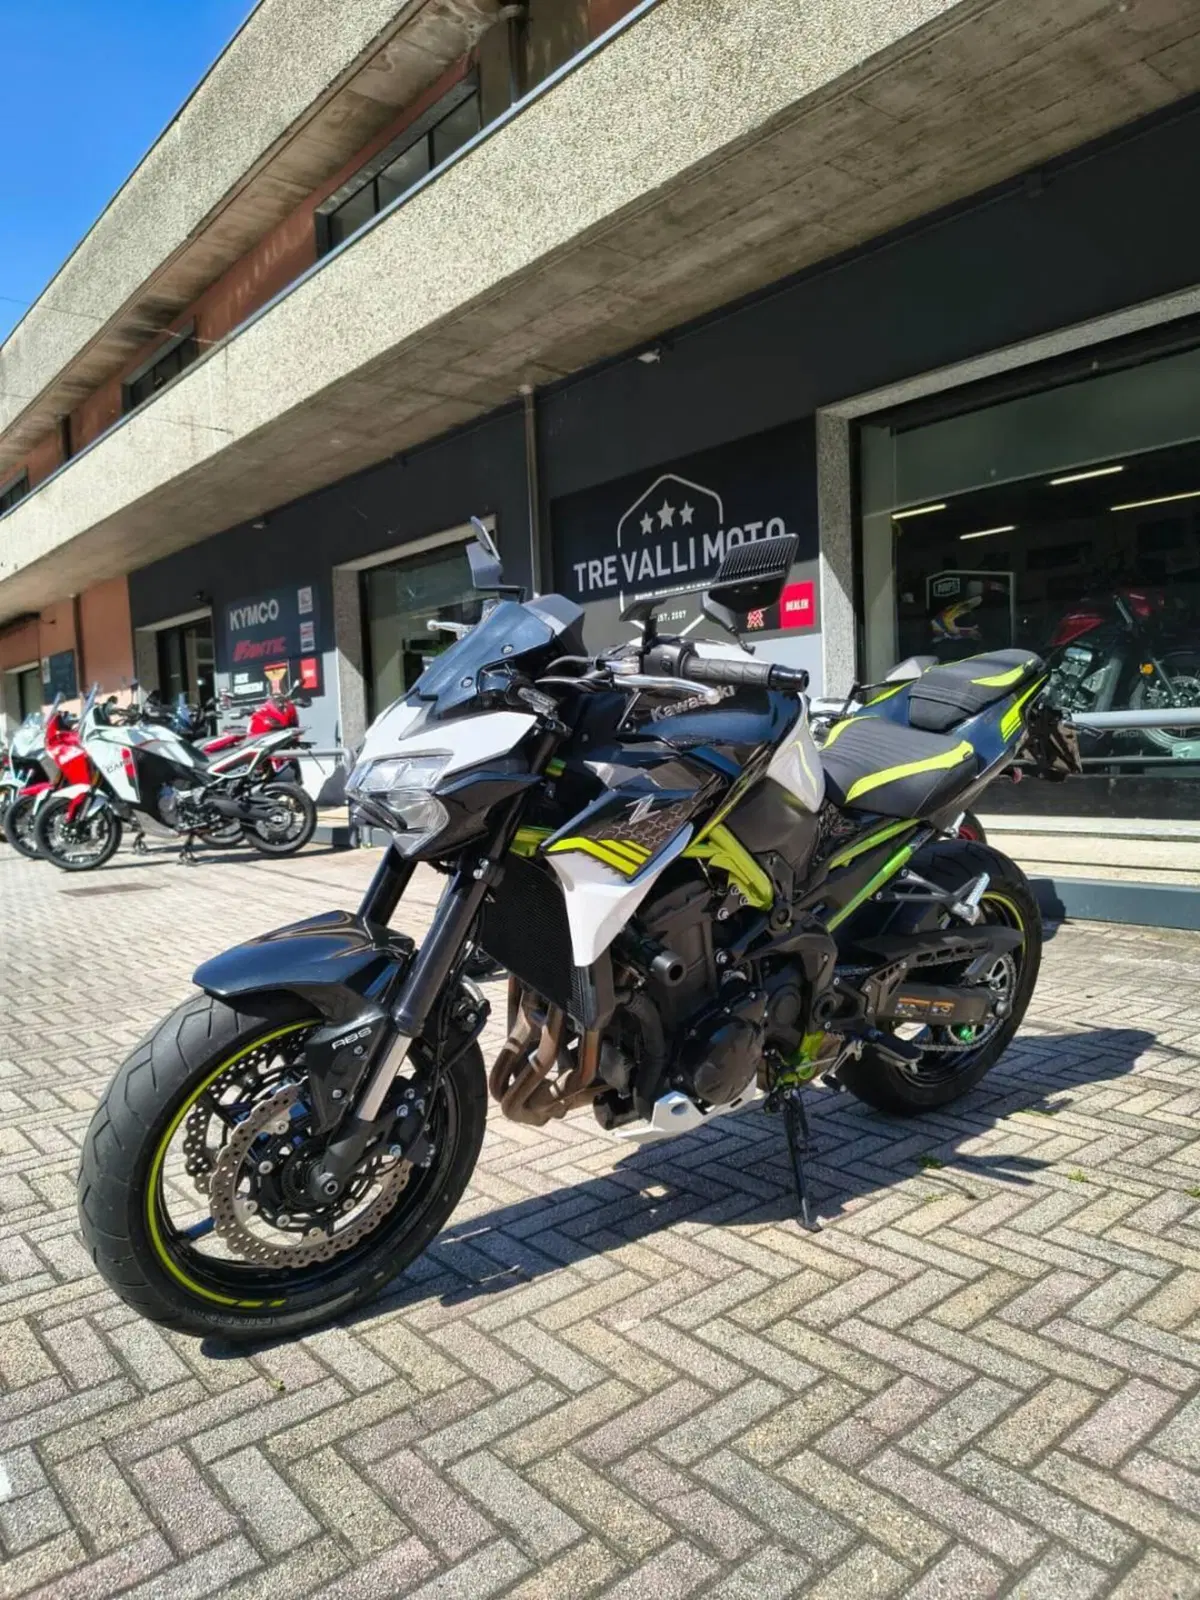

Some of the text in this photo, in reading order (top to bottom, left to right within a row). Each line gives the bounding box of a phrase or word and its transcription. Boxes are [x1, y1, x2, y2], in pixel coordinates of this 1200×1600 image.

[572, 554, 618, 592] TRE
[621, 537, 695, 581] VALLI
[229, 598, 280, 631] KYMCO
[786, 598, 809, 611] DEALER
[650, 684, 735, 722] Kawaski
[331, 1026, 372, 1050] ABS
